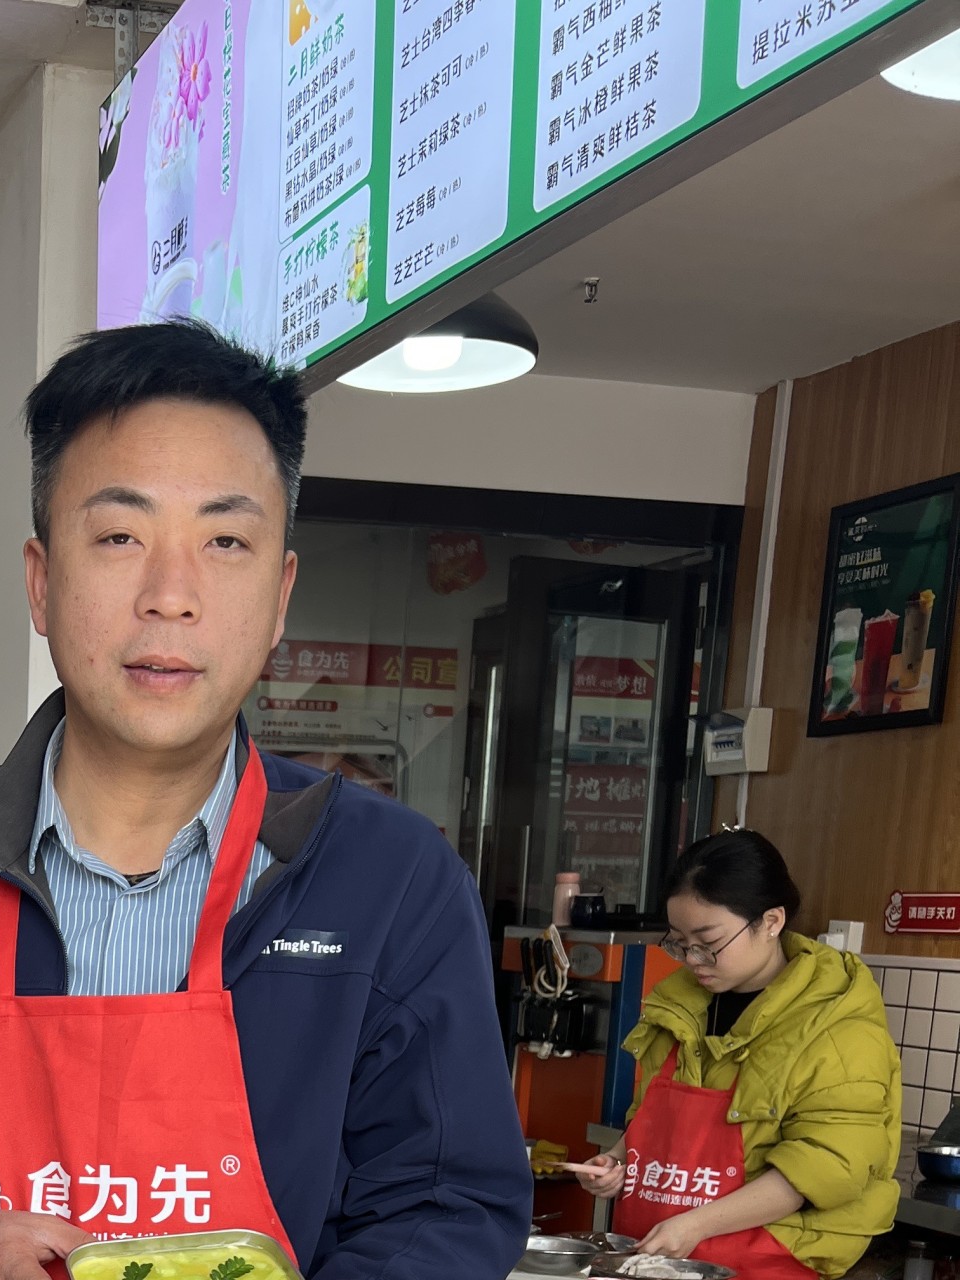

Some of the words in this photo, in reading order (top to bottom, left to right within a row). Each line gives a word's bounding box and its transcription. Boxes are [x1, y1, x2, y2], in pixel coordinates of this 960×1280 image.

[550, 2, 661, 101] 霸气金芒鲜果茶
[400, 54, 462, 124] 芝士抹茶可可
[548, 50, 659, 146] 霸气冰橙鲜果茶
[397, 112, 461, 179] 芝士茉莉绿茶
[547, 98, 657, 191] 霸气清爽鲜桔茶
[396, 185, 436, 232] 芝芝莓莓
[284, 220, 339, 285] 手打柠檬茶
[394, 242, 434, 286] 芝芝芒芒
[298, 649, 349, 669] 食为先
[273, 939, 310, 953] Tingle
[311, 940, 342, 954] Trees
[27, 1161, 211, 1224] 食为先
[642, 1160, 721, 1197] 食为先
